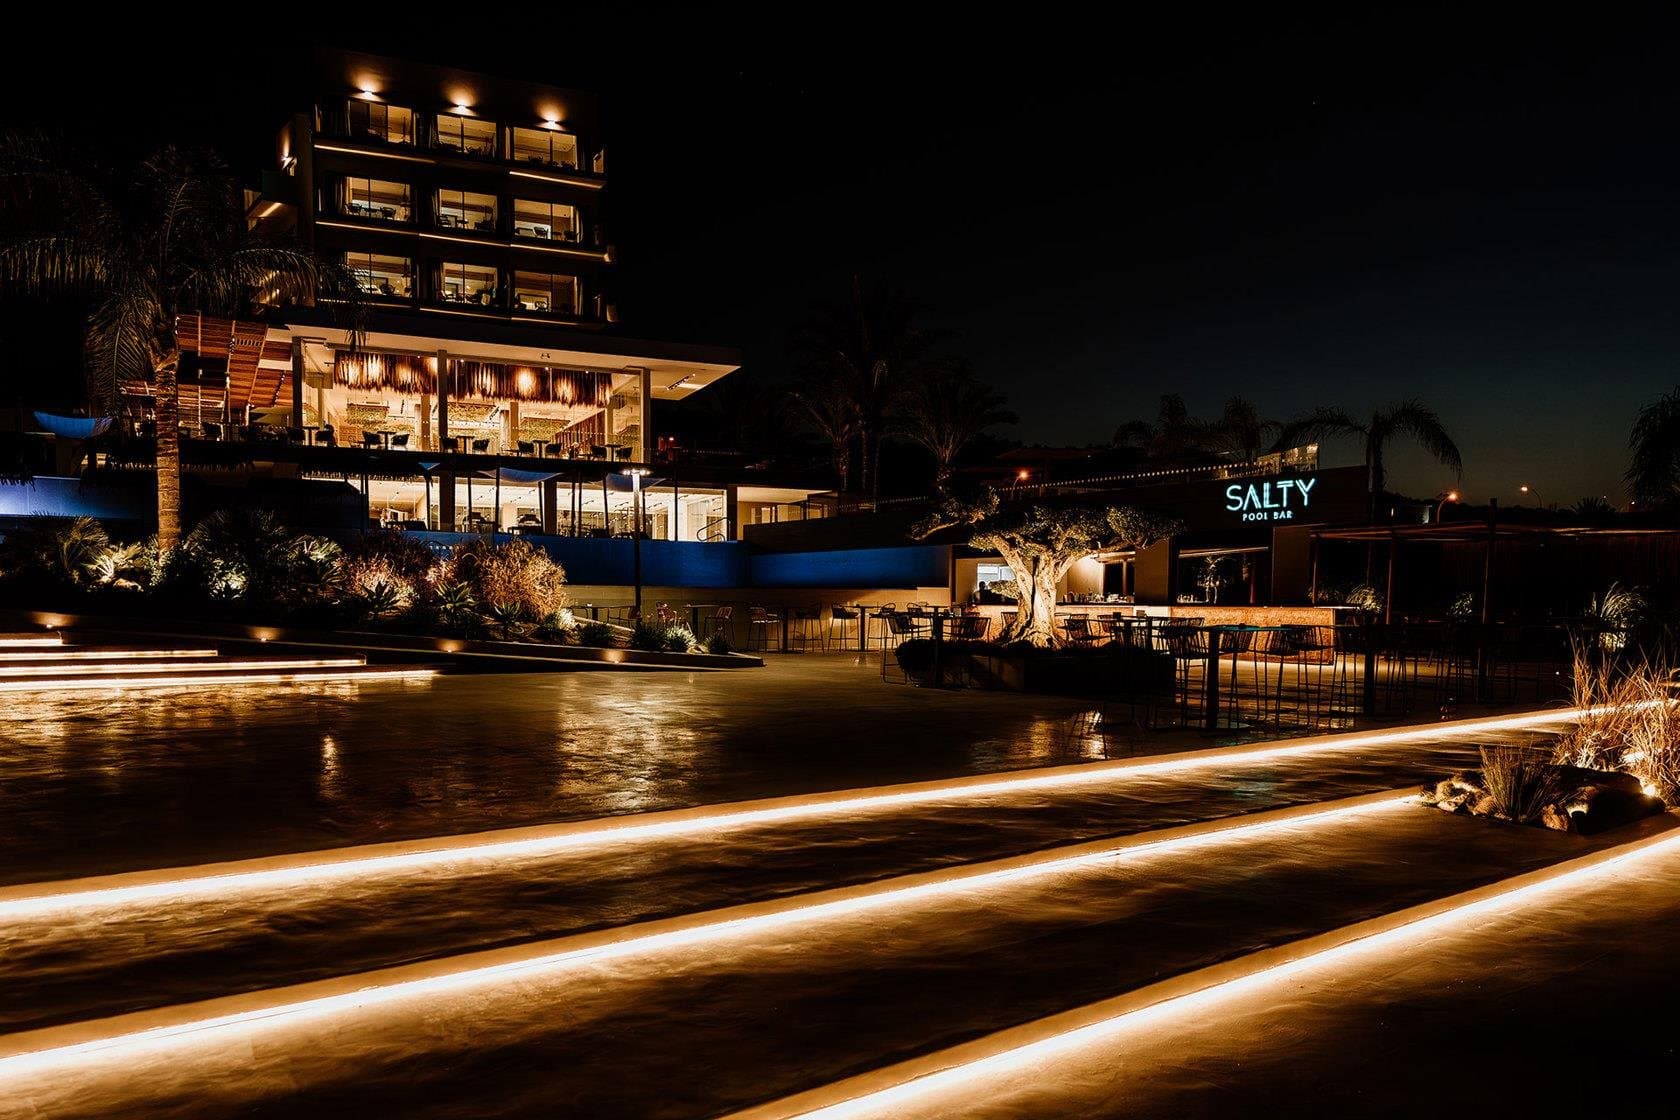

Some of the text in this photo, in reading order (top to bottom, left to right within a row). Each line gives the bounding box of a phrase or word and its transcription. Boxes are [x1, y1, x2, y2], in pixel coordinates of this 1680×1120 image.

[1226, 478, 1316, 511] SALTY
[1242, 510, 1293, 521] POOL BAR
